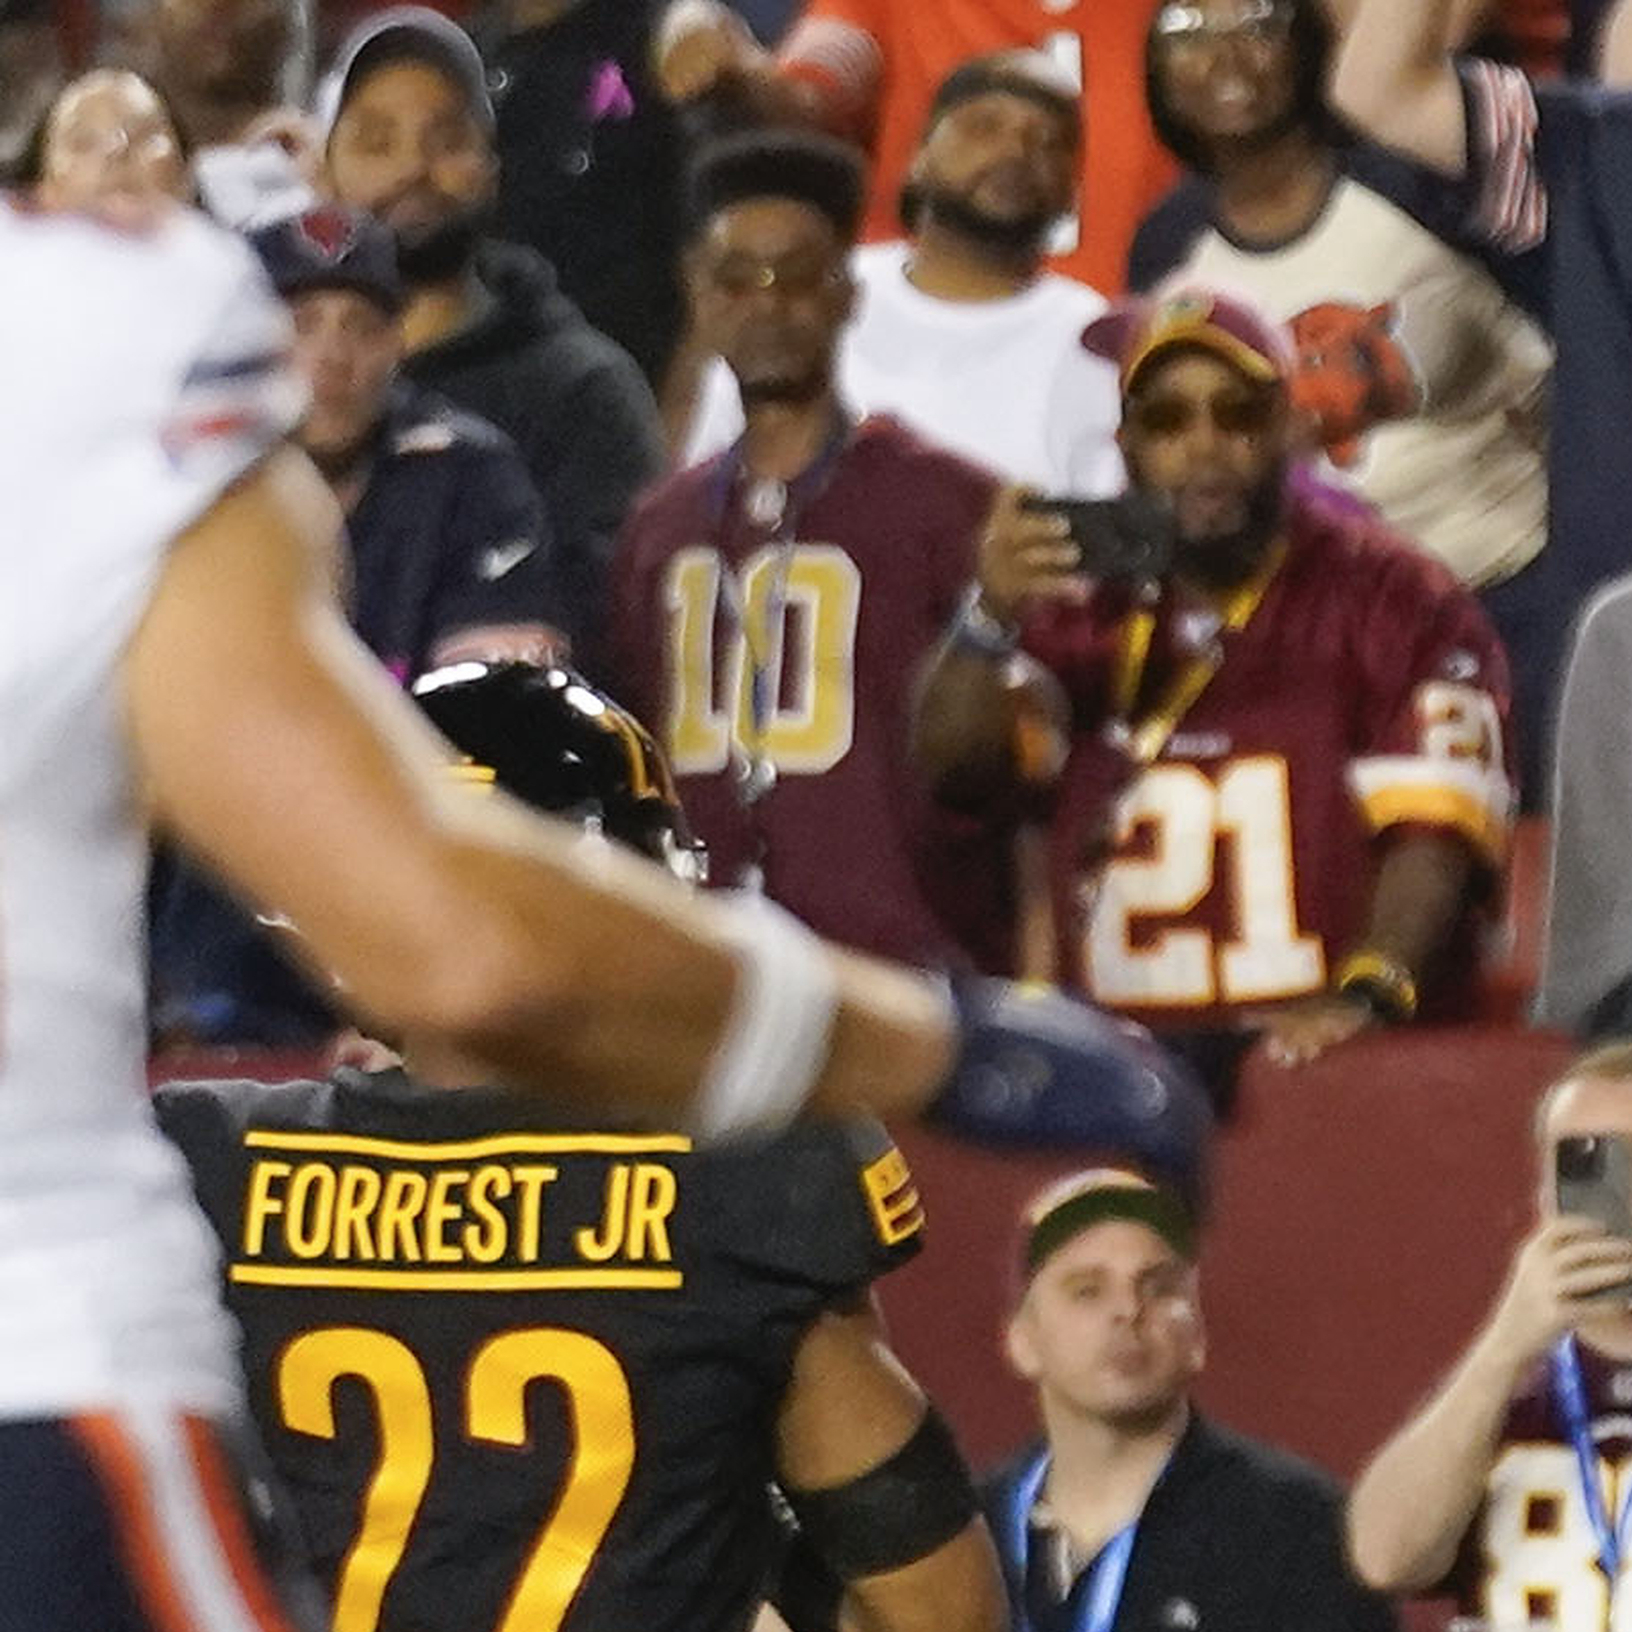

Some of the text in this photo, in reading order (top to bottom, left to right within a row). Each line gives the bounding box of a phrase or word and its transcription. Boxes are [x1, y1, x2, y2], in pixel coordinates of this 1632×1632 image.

[662, 541, 862, 774] 10
[1082, 752, 1328, 1007] 21
[244, 1161, 677, 1263] FORREST JR
